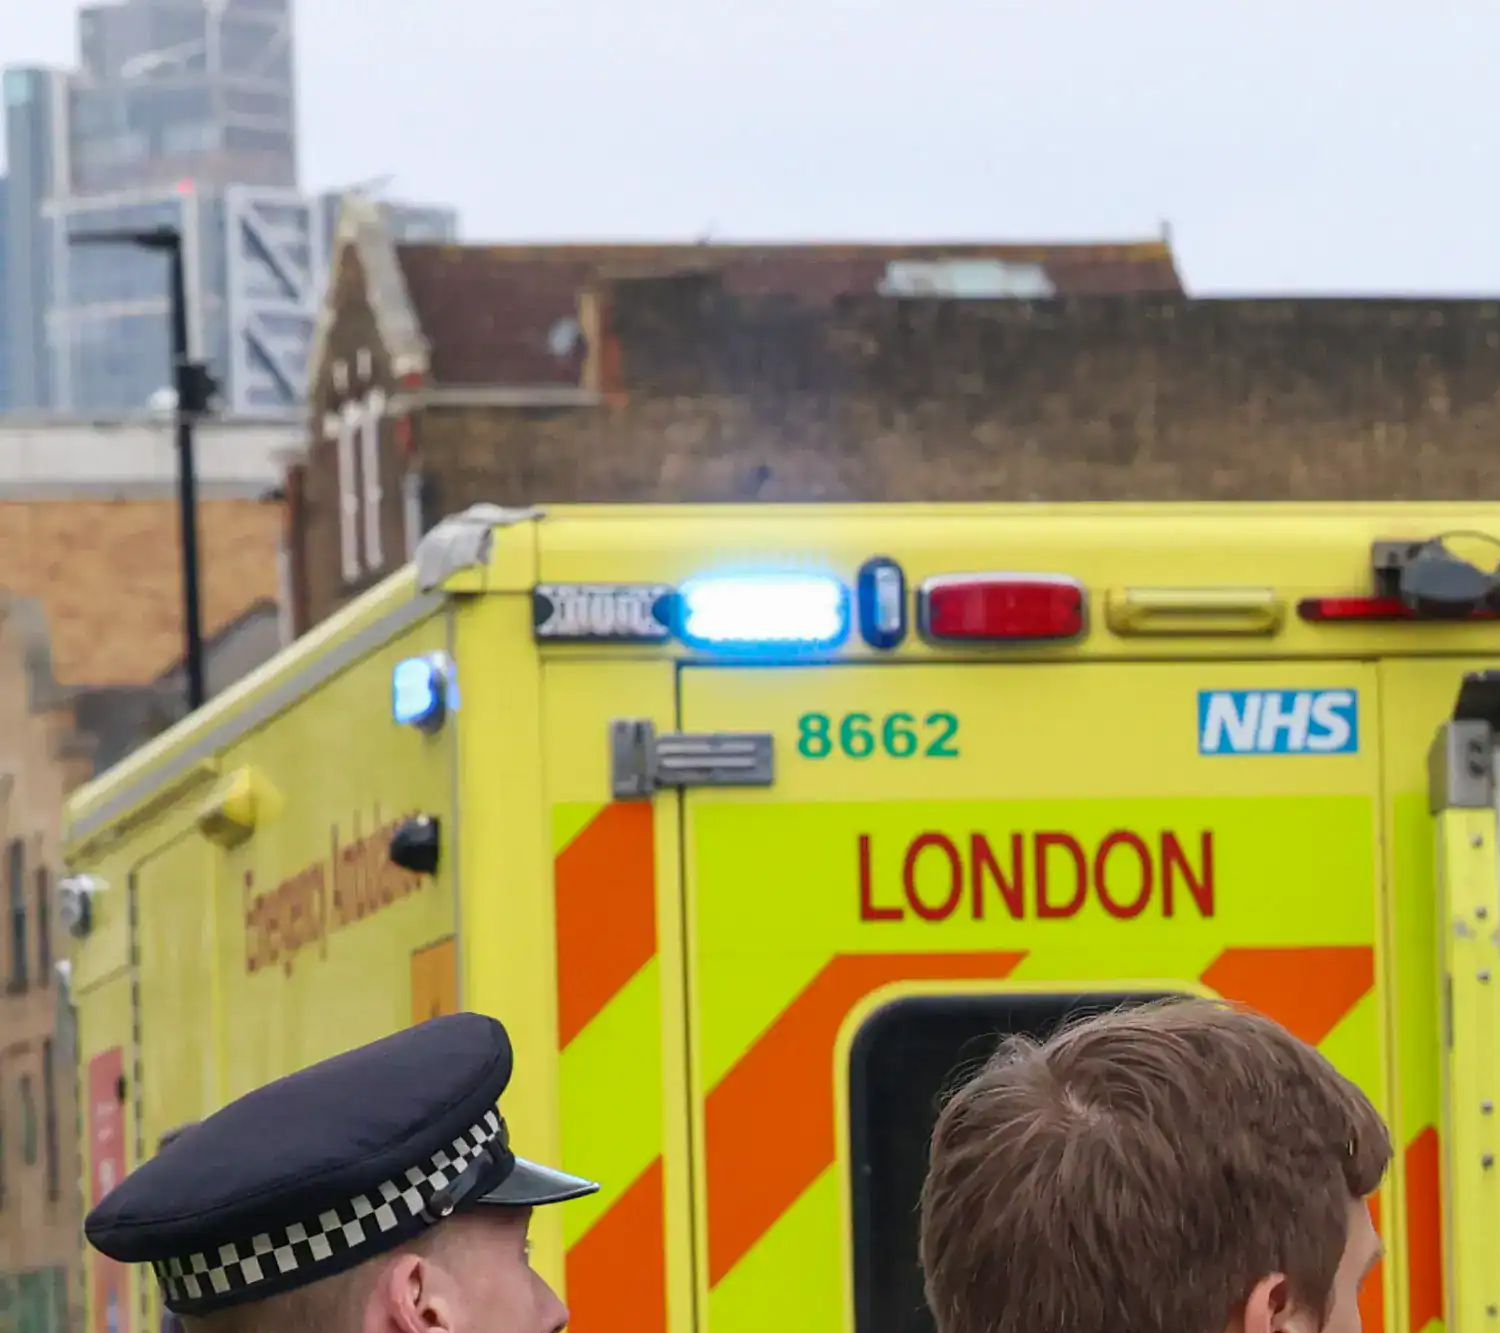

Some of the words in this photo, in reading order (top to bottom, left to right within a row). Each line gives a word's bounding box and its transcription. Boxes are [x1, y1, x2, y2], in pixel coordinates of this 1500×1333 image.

[797, 712, 960, 759] 8662
[1201, 692, 1352, 752] NHS
[857, 829, 1214, 921] LONDON
